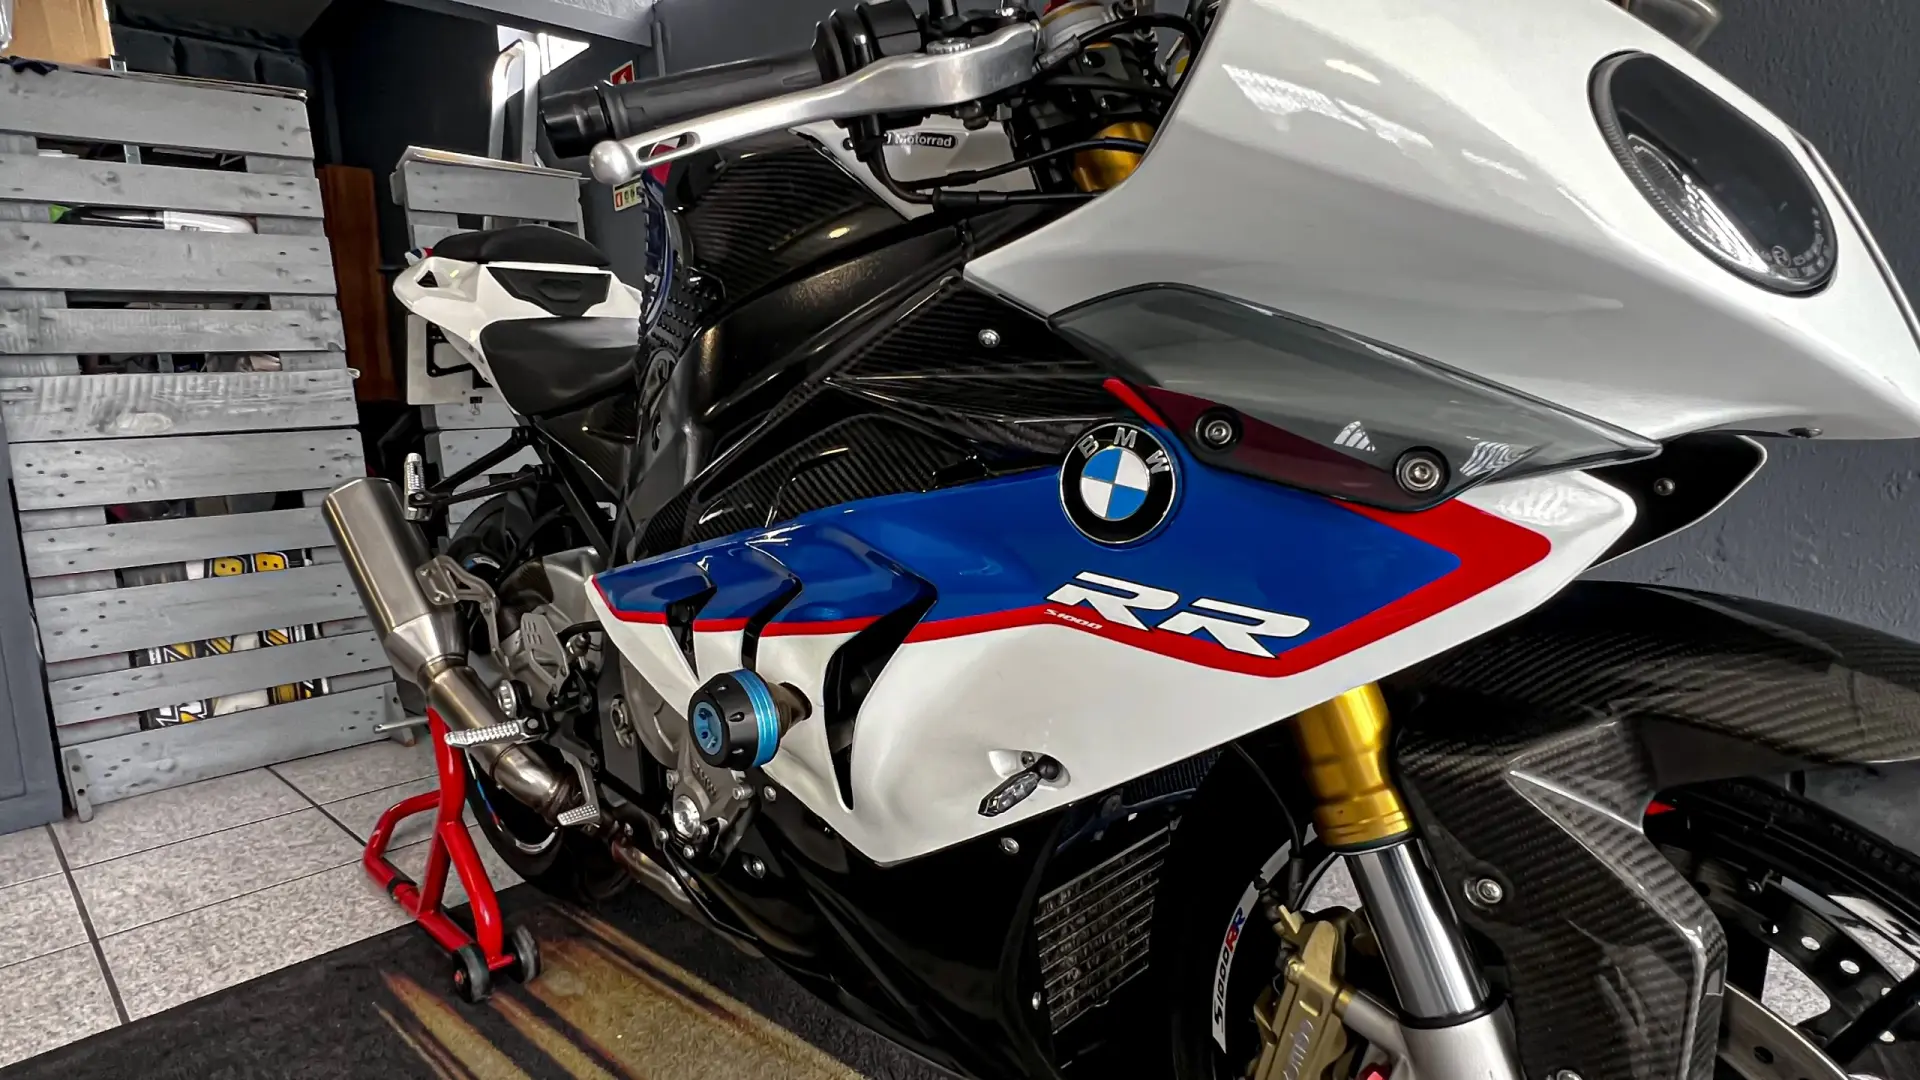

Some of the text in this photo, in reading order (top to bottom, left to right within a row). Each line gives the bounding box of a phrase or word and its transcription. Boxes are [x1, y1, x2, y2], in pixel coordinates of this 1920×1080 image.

[894, 133, 953, 147] Motorrad
[1077, 427, 1170, 475] BMW
[1044, 608, 1103, 630] S1000
[1046, 571, 1310, 659] RR
